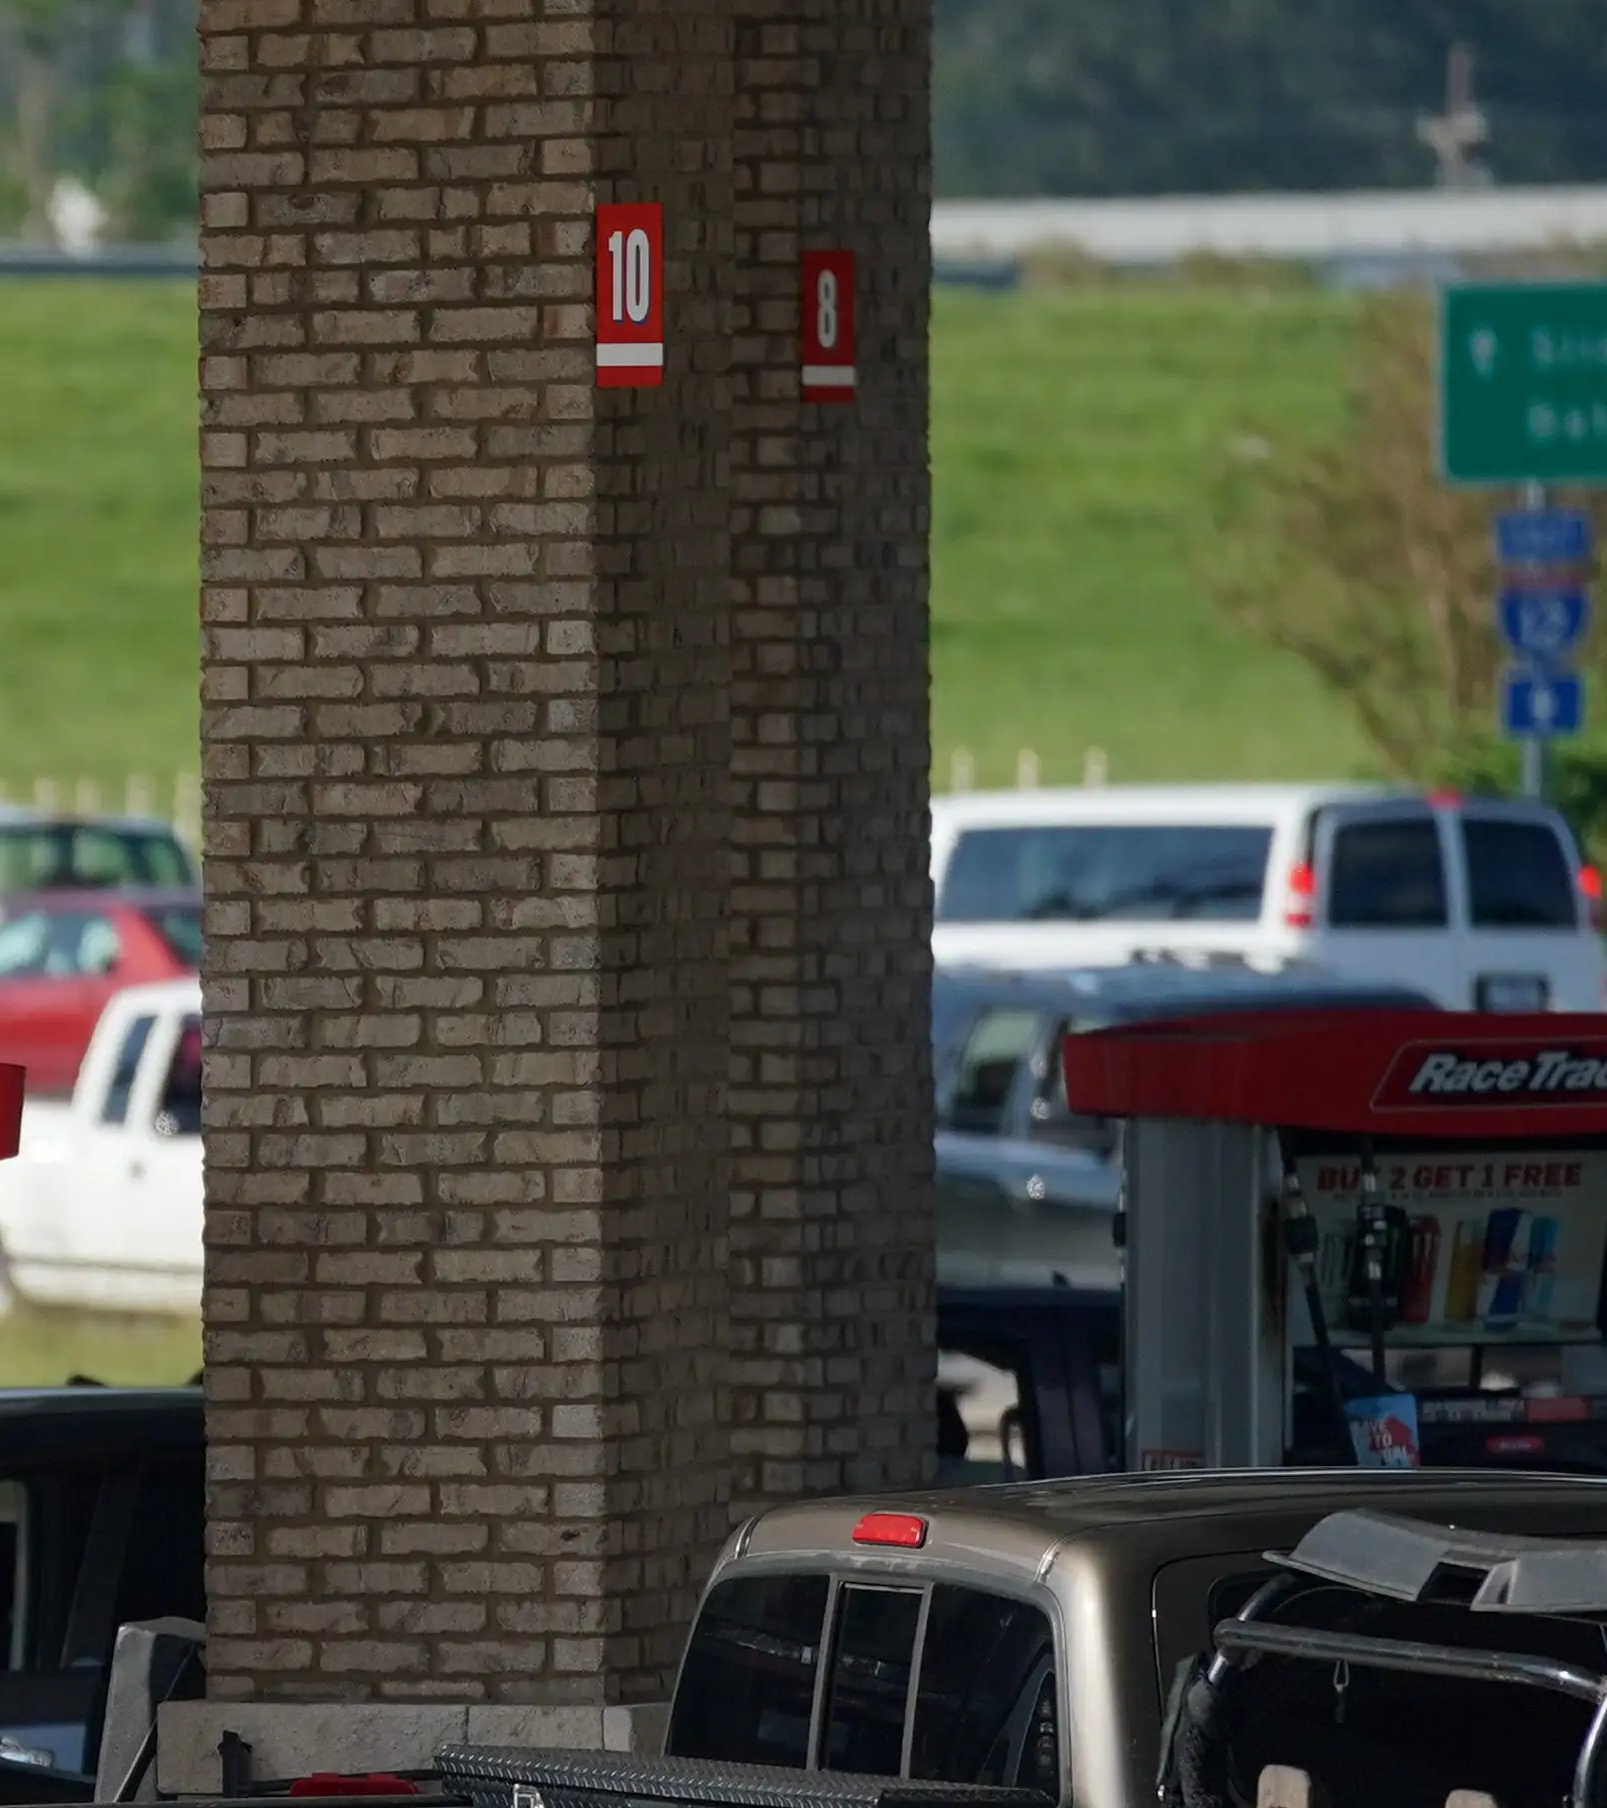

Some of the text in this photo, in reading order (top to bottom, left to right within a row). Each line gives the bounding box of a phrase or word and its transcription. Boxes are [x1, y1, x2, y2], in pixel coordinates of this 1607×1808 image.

[607, 228, 650, 323] 10
[816, 268, 839, 349] 8
[1389, 1165, 1408, 1189] 2
[1412, 1164, 1475, 1190] GET
[1502, 1162, 1584, 1189] FREE
